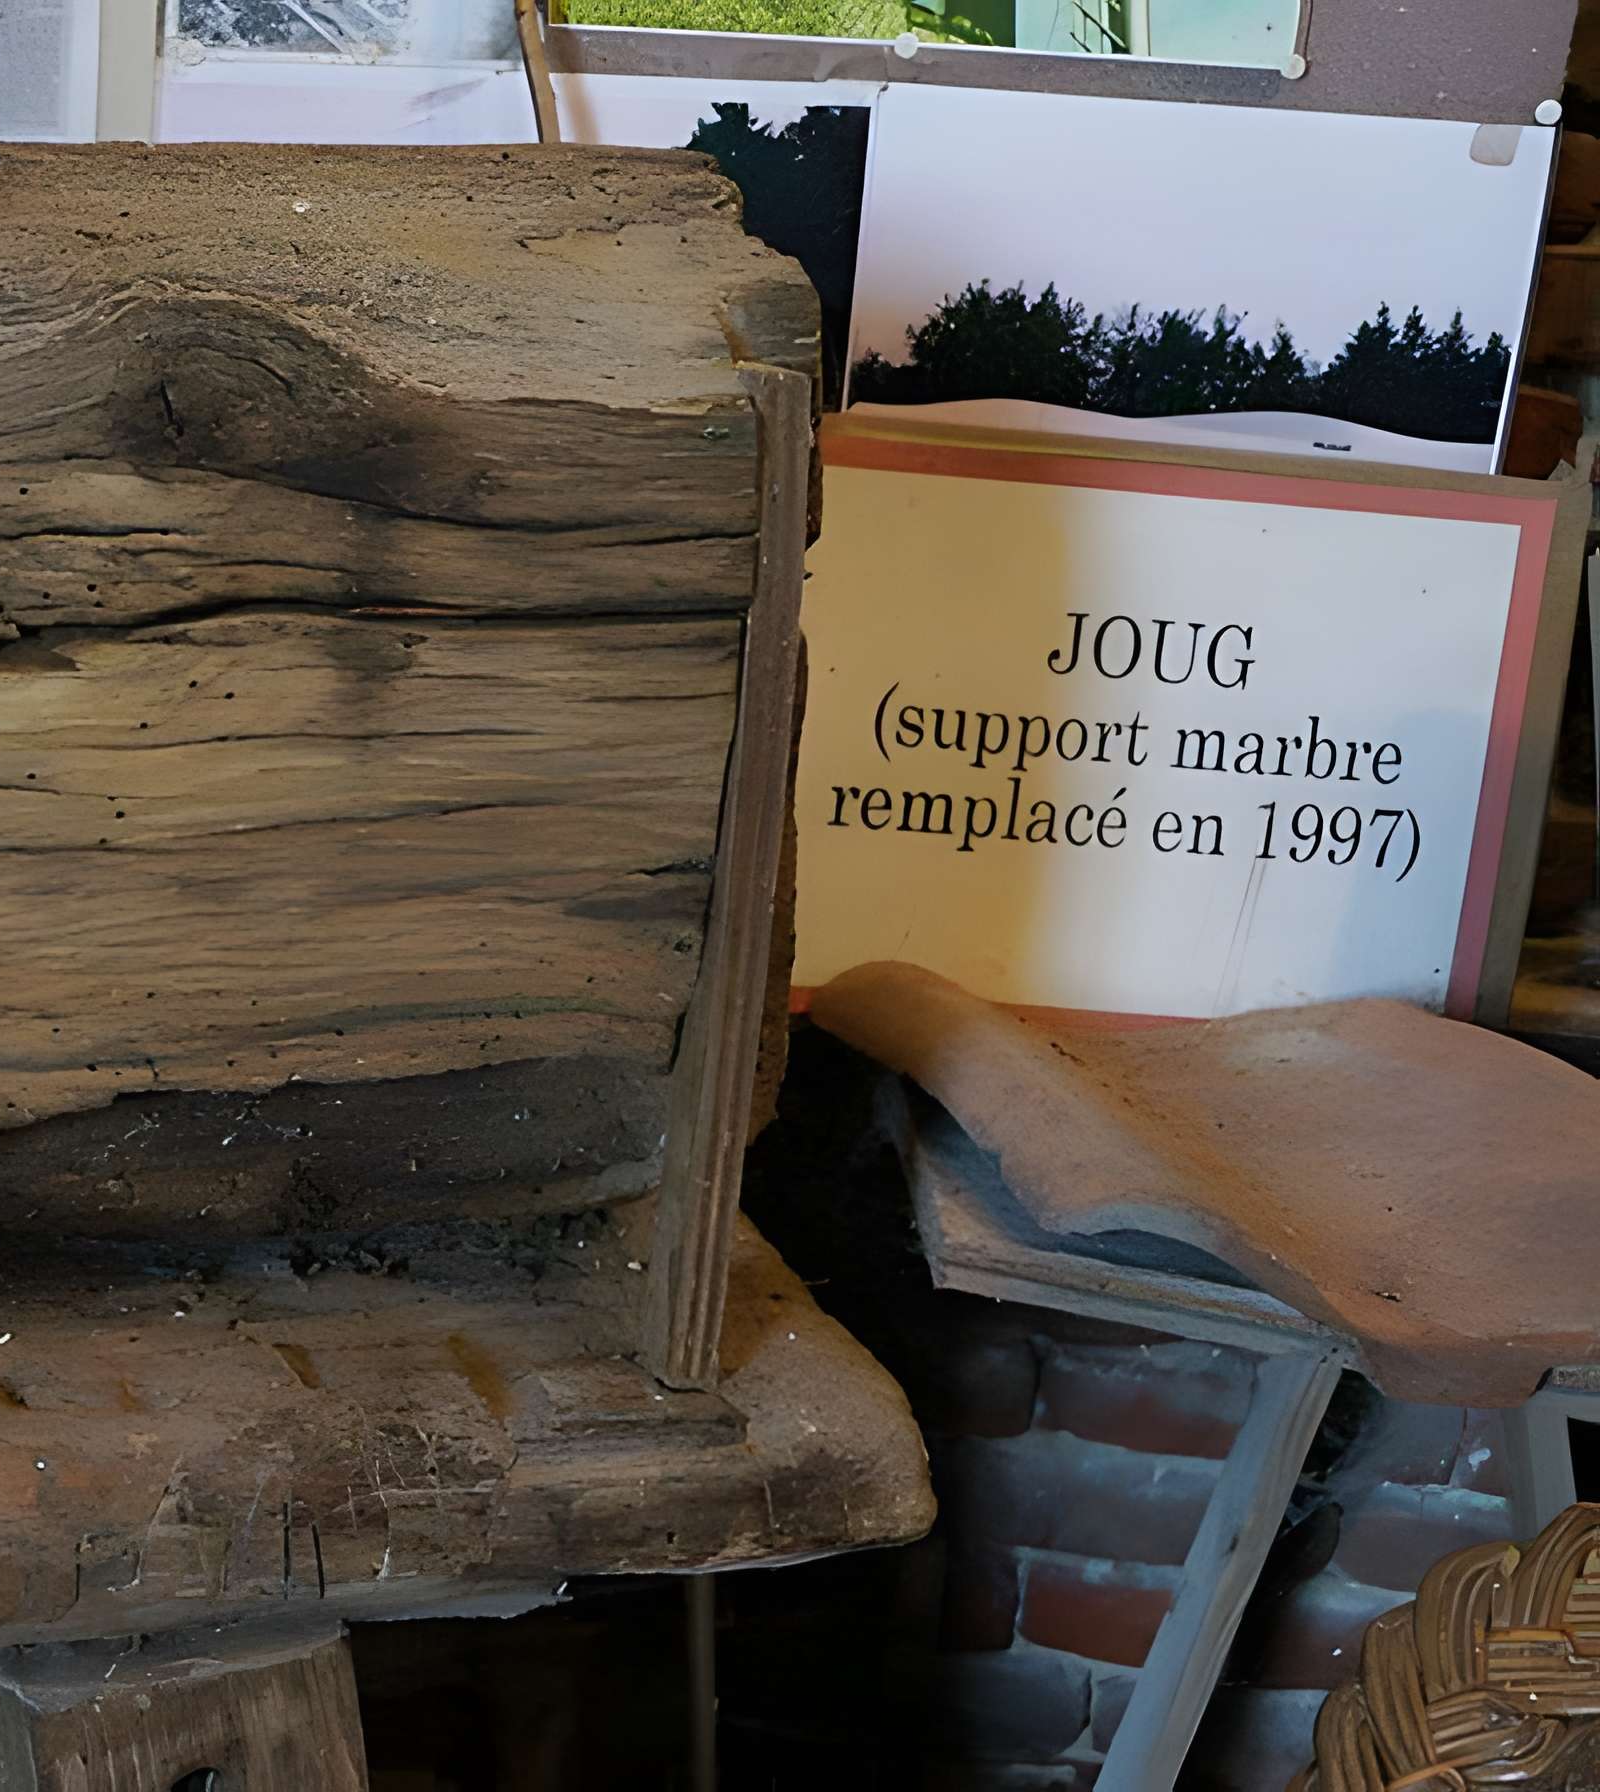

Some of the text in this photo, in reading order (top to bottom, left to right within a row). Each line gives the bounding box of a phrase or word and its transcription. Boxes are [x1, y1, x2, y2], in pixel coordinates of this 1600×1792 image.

[1047, 611, 1257, 691] JOUG
[873, 680, 1403, 786] (support marbre
[827, 777, 1422, 883] remplacé en 1997)
